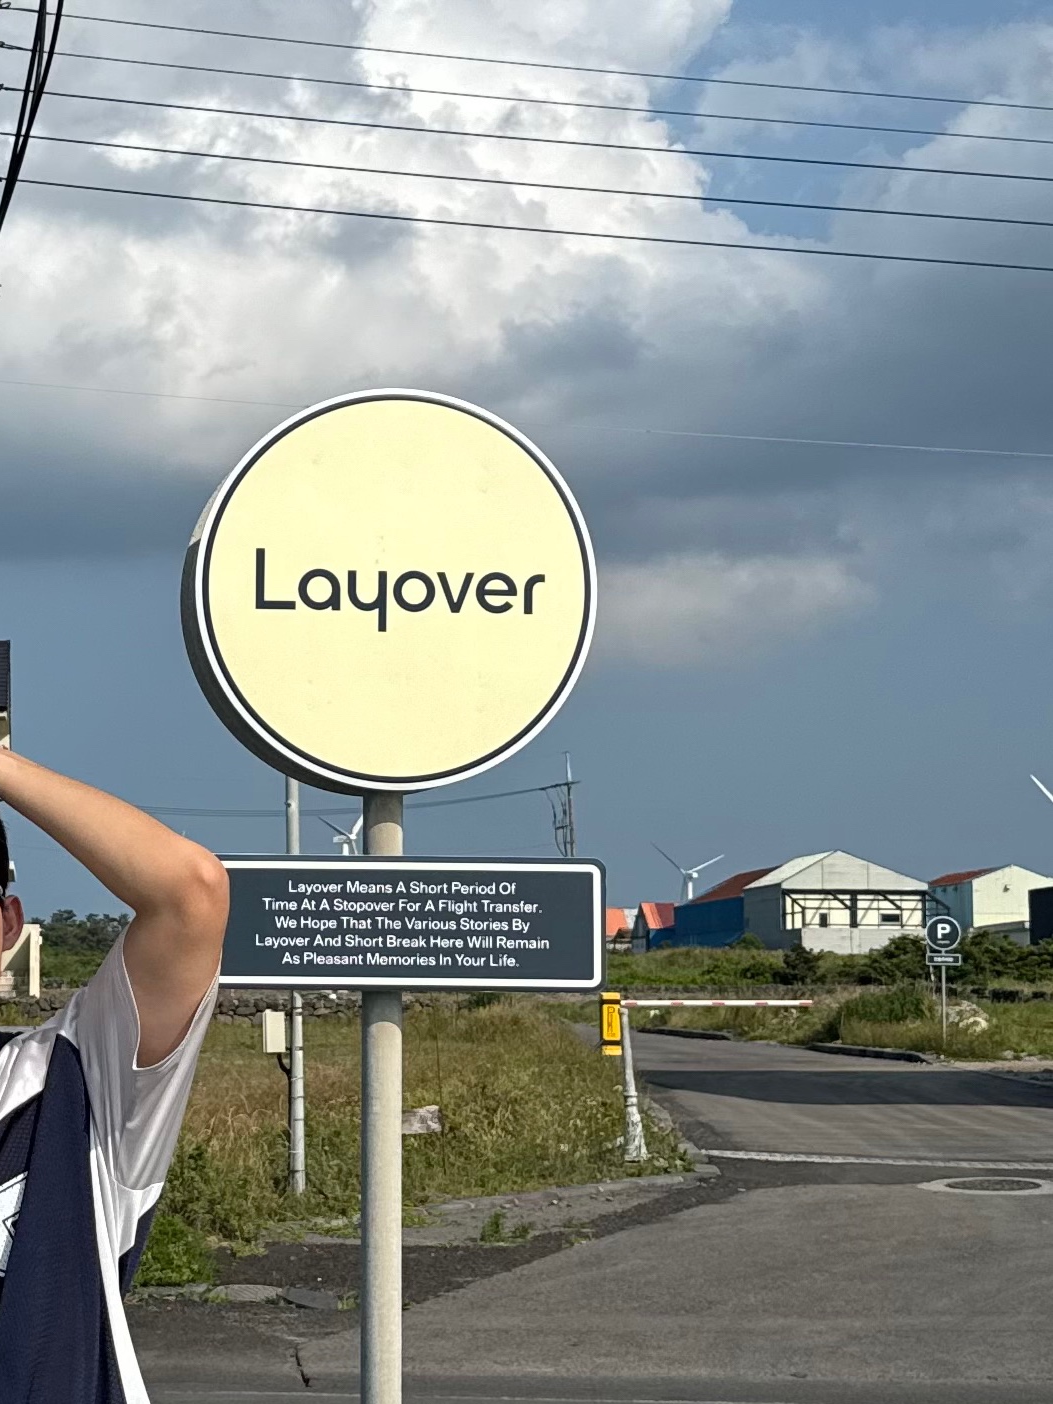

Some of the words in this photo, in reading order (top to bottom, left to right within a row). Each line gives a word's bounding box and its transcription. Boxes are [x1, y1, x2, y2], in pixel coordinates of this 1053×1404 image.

[255, 547, 546, 633] Layover
[288, 879, 344, 896] Layover
[346, 880, 393, 894] Means
[395, 881, 407, 894] A
[409, 881, 449, 895] Short
[451, 881, 496, 895] Period
[498, 882, 517, 895] Of
[261, 897, 298, 911] Time
[300, 897, 317, 911] At
[318, 898, 331, 912] A
[333, 898, 396, 915] Stopover
[398, 899, 422, 912] For
[424, 899, 436, 913] A
[438, 899, 478, 916] Flight
[480, 900, 543, 914] Transfer.
[274, 915, 298, 929] We
[300, 915, 338, 932] Hope
[339, 916, 373, 930] That
[374, 916, 402, 930] The
[404, 917, 457, 931] Various
[459, 917, 510, 931] Stories
[511, 918, 531, 935] By
[937, 923, 951, 939] P
[255, 933, 311, 949] Layover
[312, 934, 342, 948] And
[344, 934, 384, 948] Short
[386, 934, 427, 948] Break
[429, 935, 464, 949] Here
[466, 935, 494, 949] Will
[496, 935, 550, 950] Remain
[281, 951, 301, 965] As
[303, 951, 364, 966] Pleasant
[366, 952, 437, 966] Memories
[439, 953, 452, 966] In
[454, 953, 488, 967] Your
[489, 953, 520, 968] Life.
